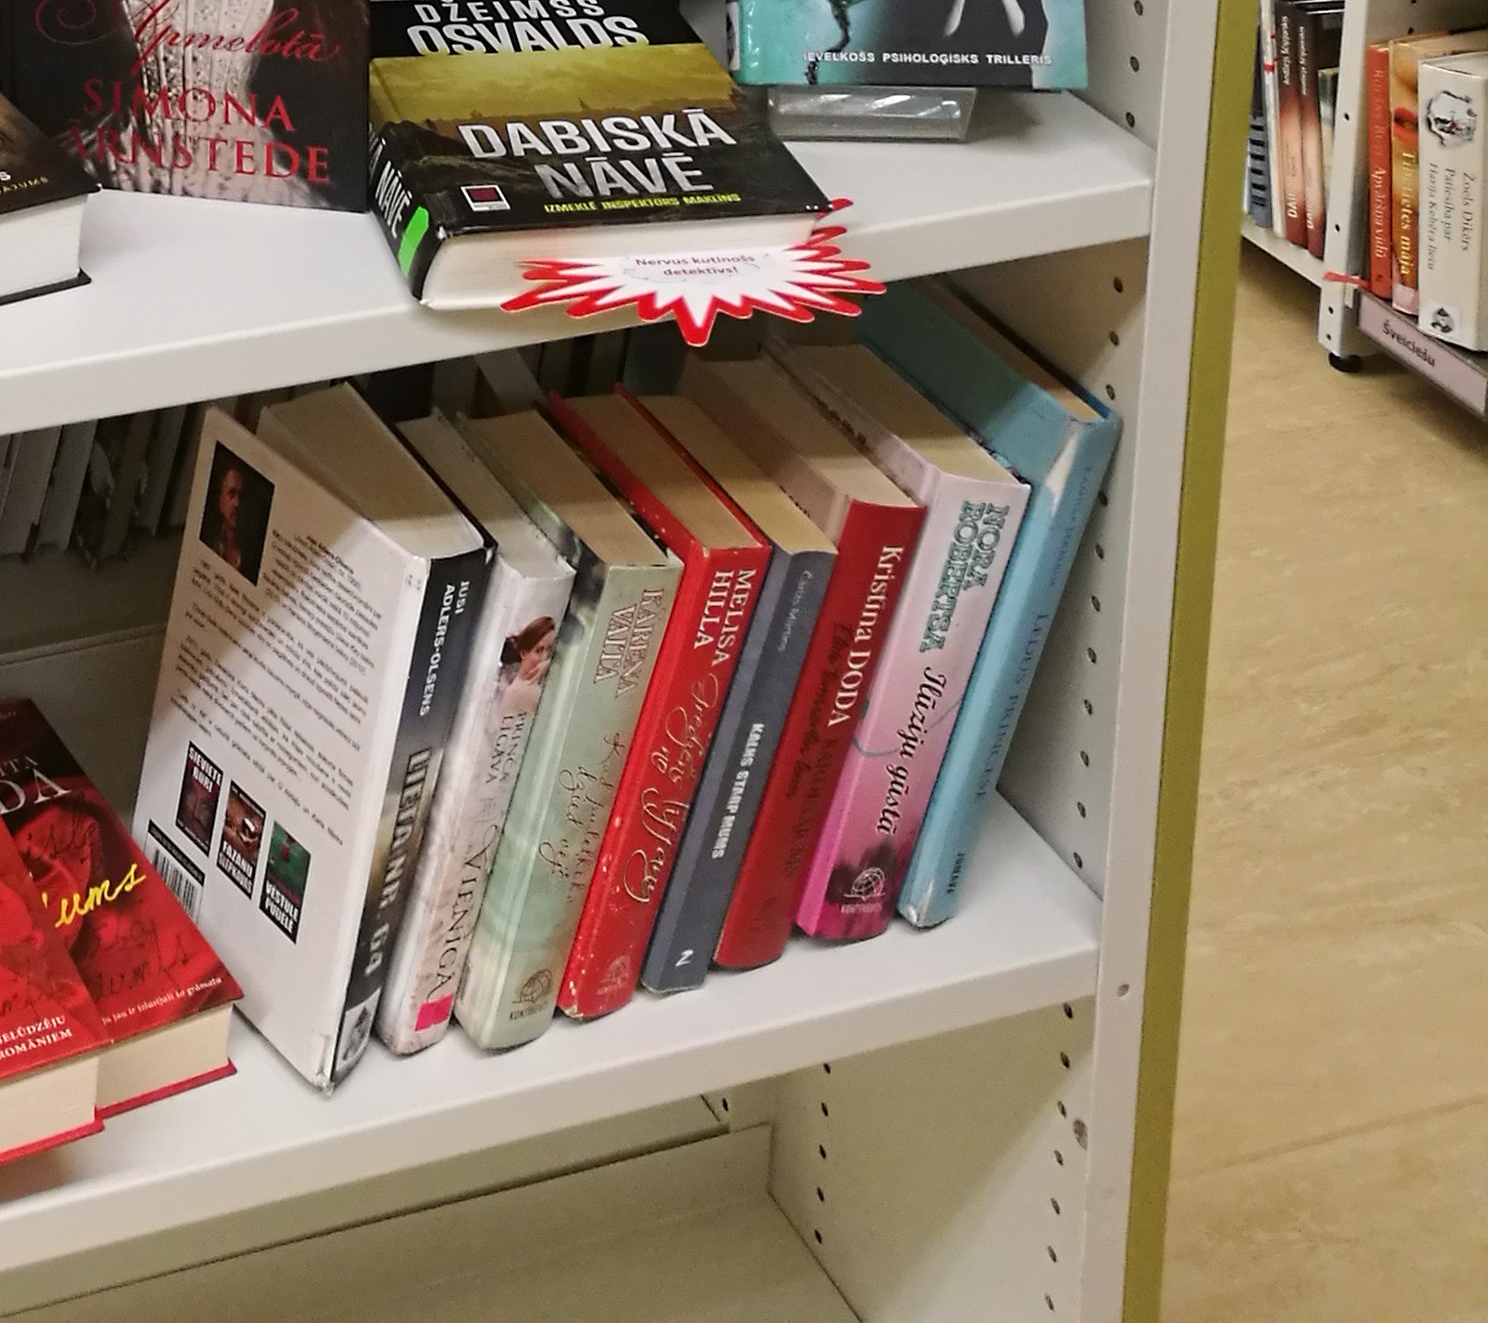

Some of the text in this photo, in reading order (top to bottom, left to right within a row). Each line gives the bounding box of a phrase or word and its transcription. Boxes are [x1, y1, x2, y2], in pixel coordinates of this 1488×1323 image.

[407, 15, 650, 56] OSVALDS
[881, 50, 980, 66] PSIHOLOĢISKS
[985, 53, 1053, 66] TRILLERIS
[83, 78, 296, 133] SIMONA
[458, 107, 738, 159] DABISKĀ
[68, 118, 331, 184] ĀRNSTEDE
[532, 153, 714, 200] NĀVĒ
[374, 159, 414, 239] NĀVĒ
[601, 196, 681, 212] INSPEKTORS
[635, 254, 690, 268] Nervus
[963, 501, 1010, 590] NORA
[453, 579, 471, 616] JUSI
[918, 500, 988, 654] ROBERTSA
[693, 569, 734, 651] HILLA
[710, 569, 757, 667] MELISA
[418, 583, 456, 718] ADLERS-OLSENS
[827, 648, 873, 728] DODA
